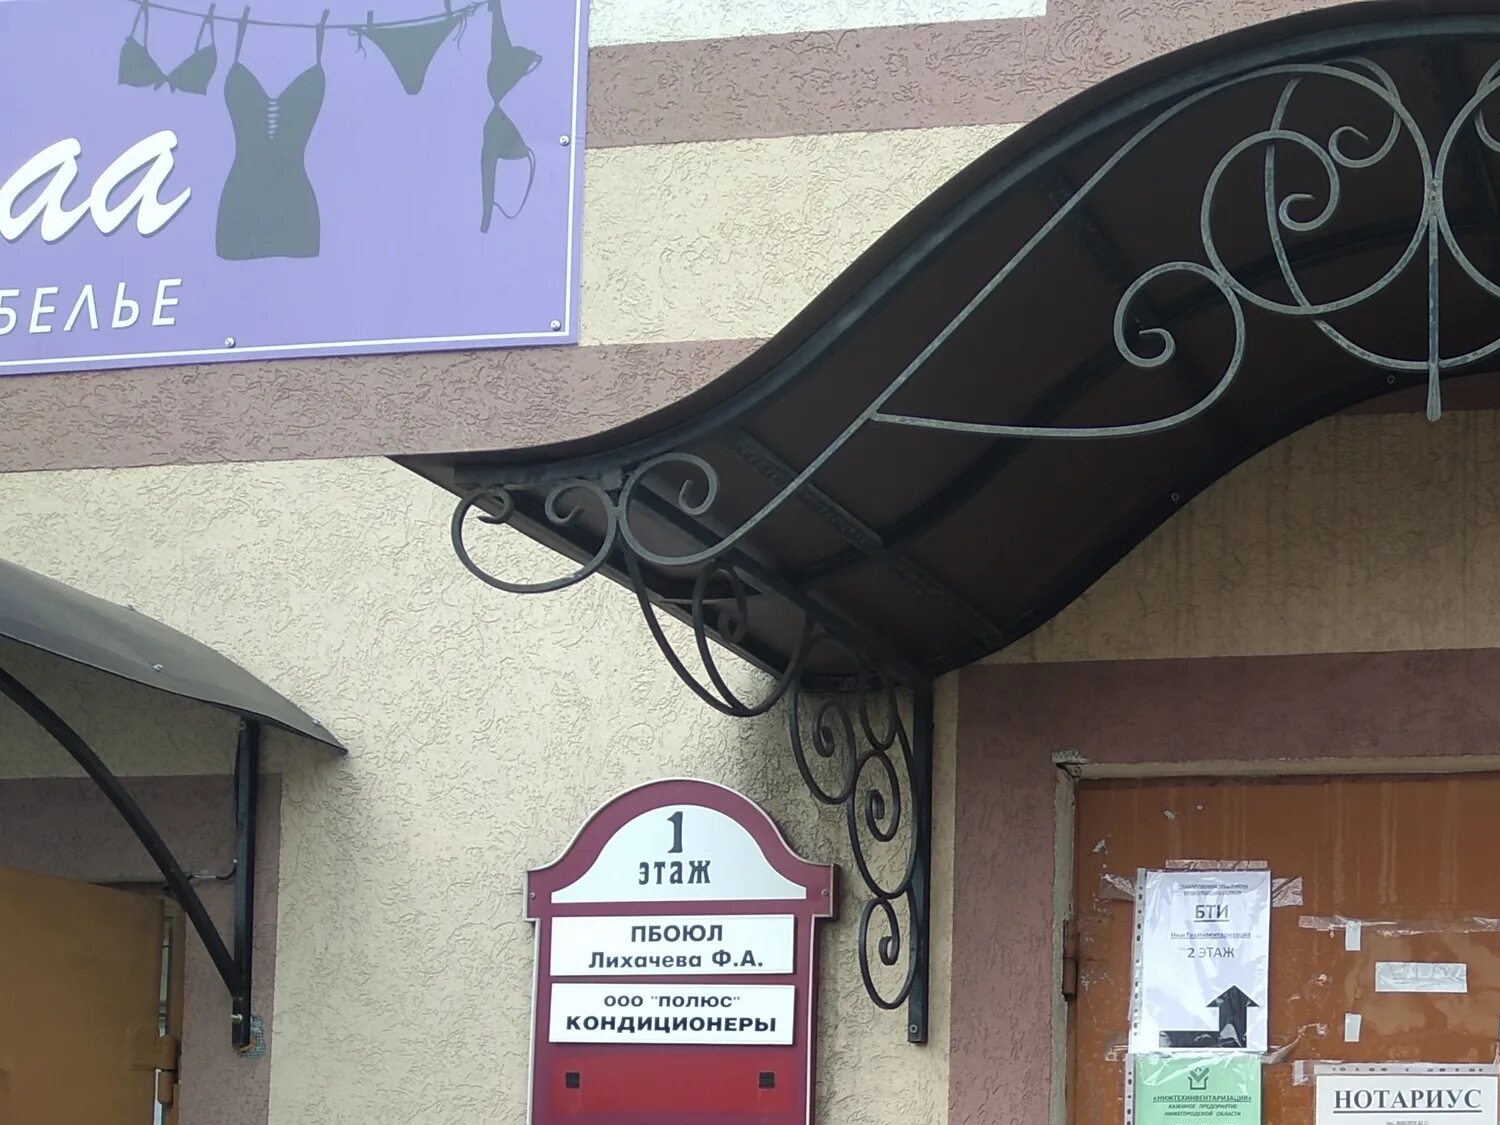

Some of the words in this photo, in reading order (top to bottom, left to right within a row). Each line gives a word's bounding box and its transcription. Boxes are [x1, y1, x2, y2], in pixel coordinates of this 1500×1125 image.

[0, 278, 182, 335] БЕЛЬЕ
[667, 811, 684, 854] 1
[638, 860, 711, 885] этаж
[1195, 904, 1229, 919] БТИ
[631, 924, 723, 943] ПБОЮЛ
[588, 951, 702, 969] Лихачева
[711, 949, 763, 968] Ф.А.
[1187, 947, 1195, 958] 2
[1199, 947, 1235, 958] ЭТАЖ
[603, 995, 644, 1008] ООО
[566, 1016, 776, 1033] КОНДИЦИОНЕРЫ
[1334, 1089, 1482, 1109] НОТАРИУС
